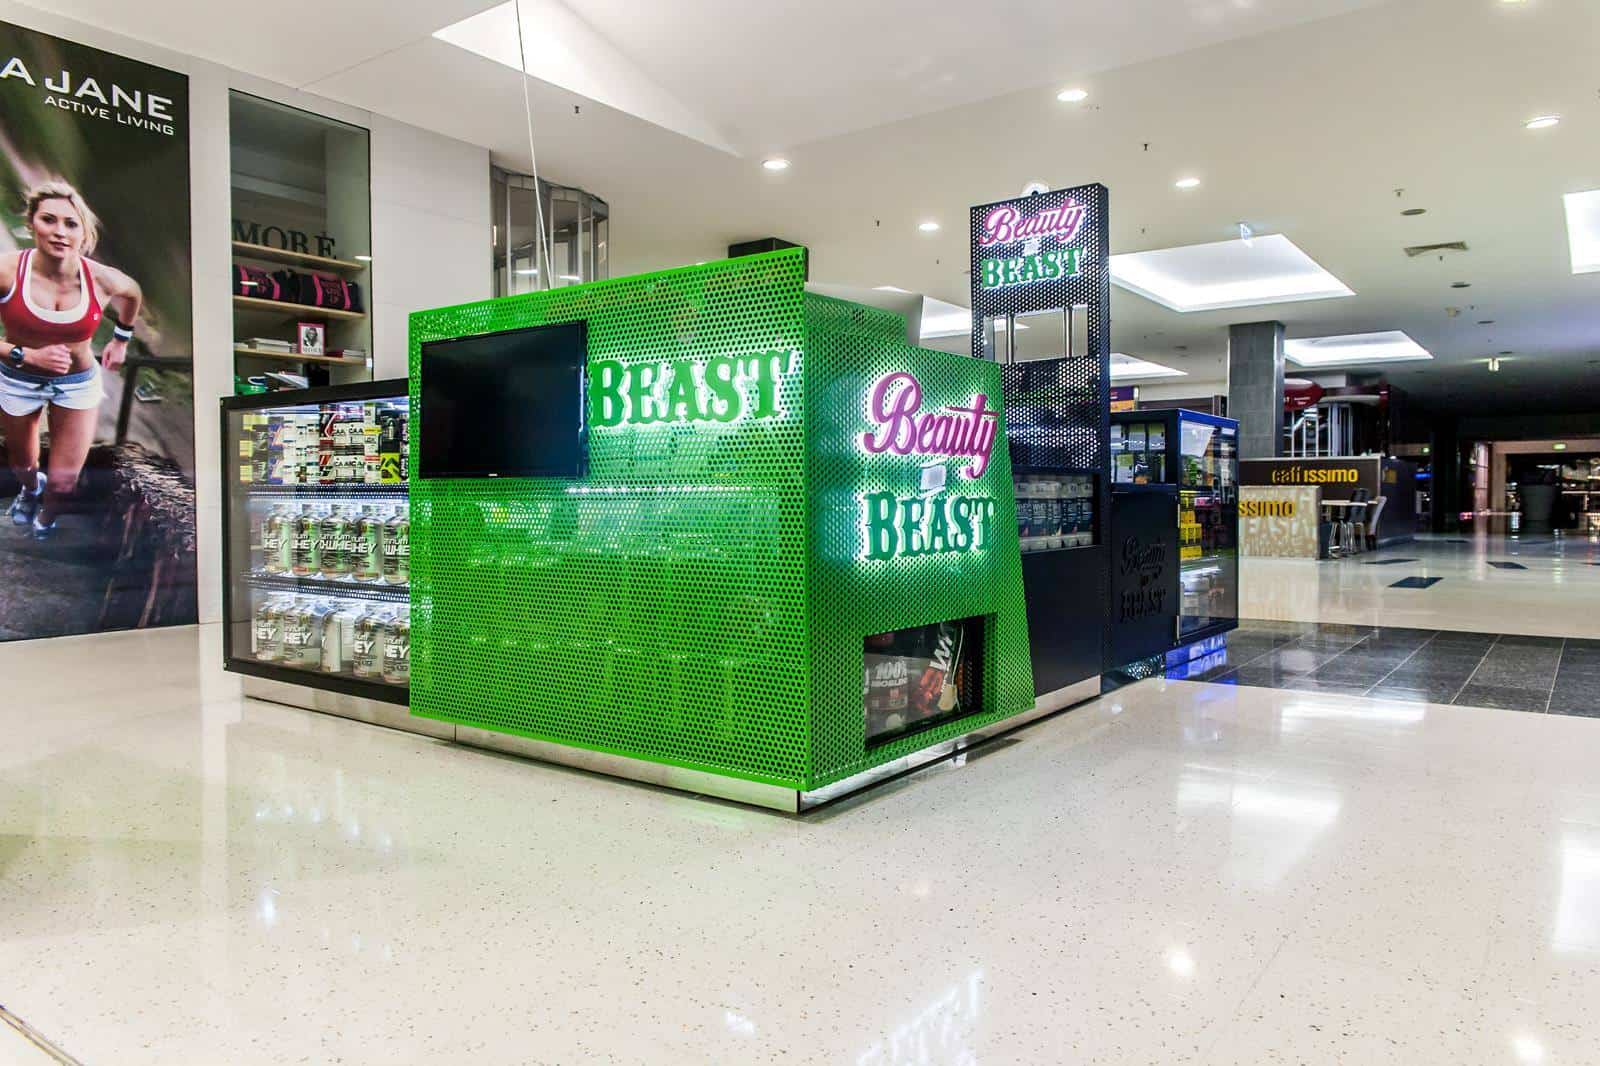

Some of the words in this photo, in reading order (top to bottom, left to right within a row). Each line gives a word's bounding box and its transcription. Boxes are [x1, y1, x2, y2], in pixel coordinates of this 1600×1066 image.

[44, 95, 111, 120] ACTIVE
[116, 112, 175, 136] LIVING
[45, 70, 174, 121] JANE
[232, 219, 336, 260] MORE
[978, 197, 1085, 245] Beauty
[981, 247, 1084, 289] BEAST
[588, 350, 792, 427] BEAST
[863, 372, 1000, 480] Beauty
[863, 491, 998, 561] BEAST
